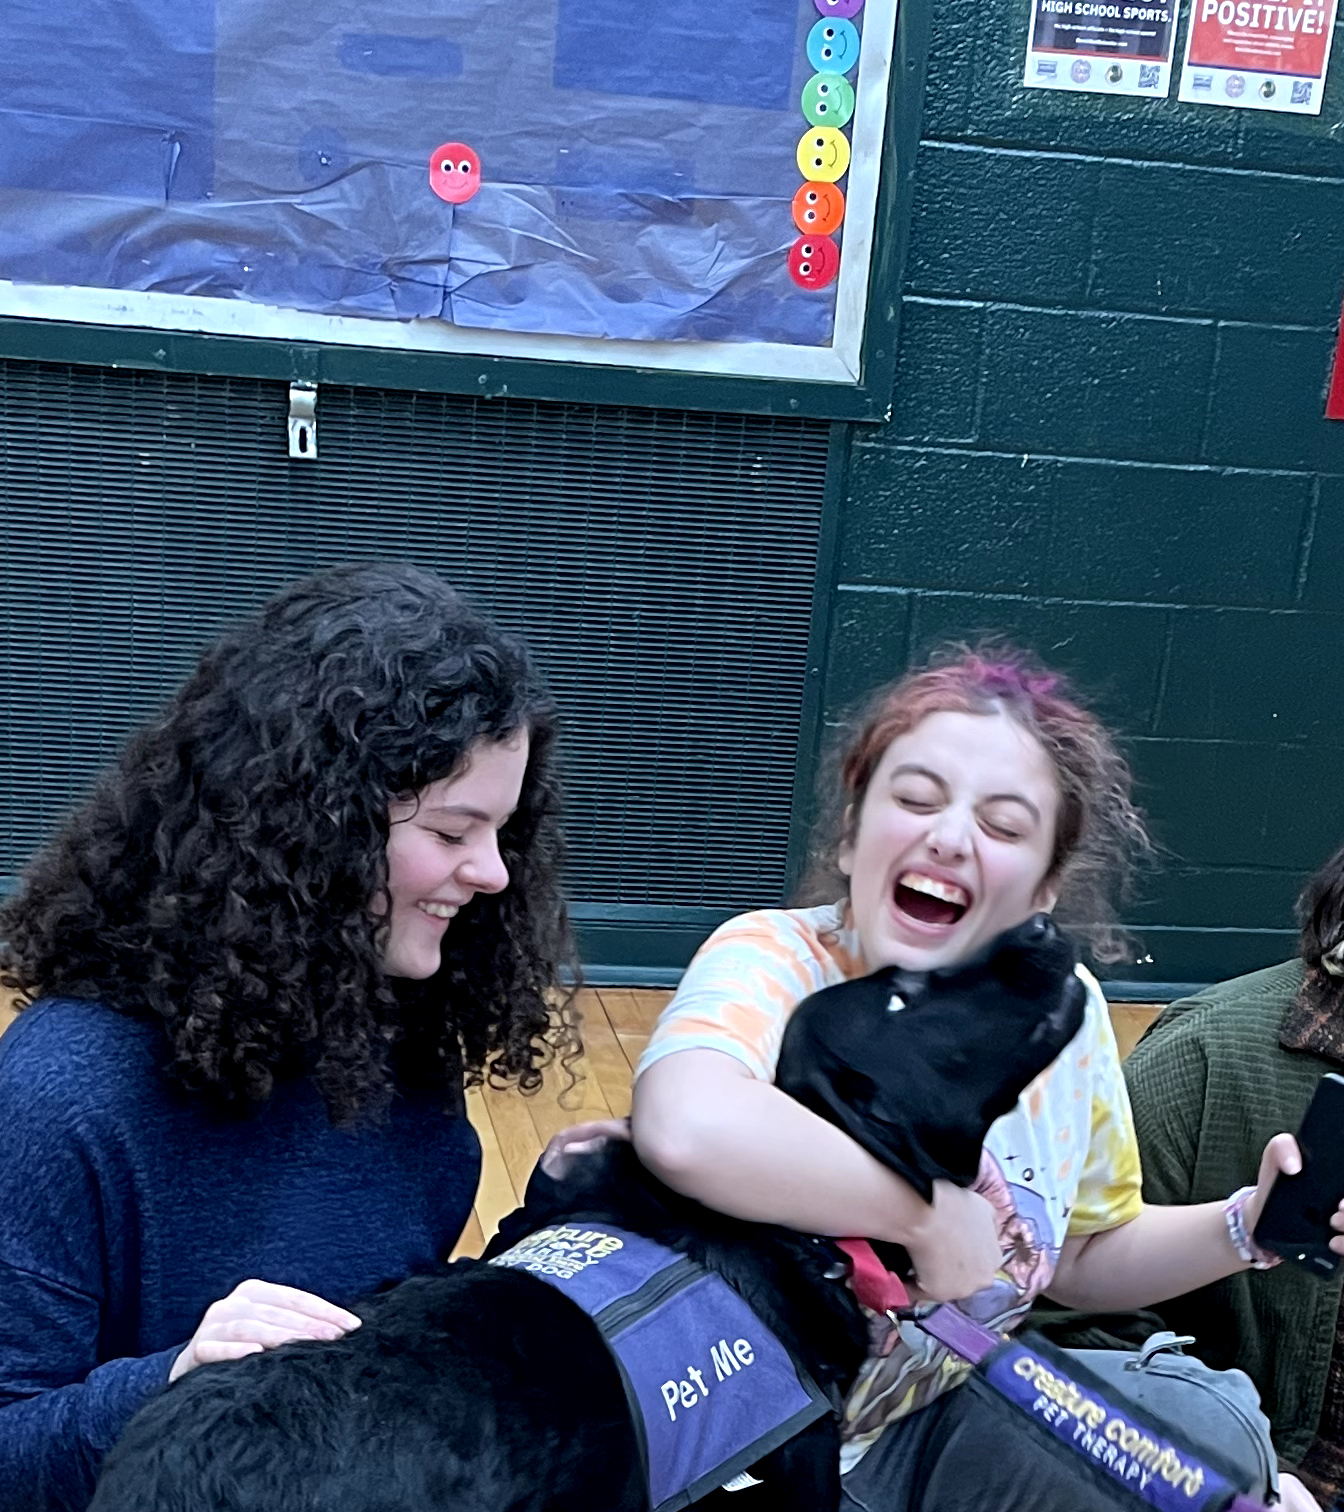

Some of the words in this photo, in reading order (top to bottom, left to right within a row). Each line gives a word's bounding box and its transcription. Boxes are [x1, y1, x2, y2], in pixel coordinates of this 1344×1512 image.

[1041, 0, 1073, 14] HIGH
[1074, 3, 1121, 18] SCHOOL
[1123, 7, 1172, 22] SPORTS.
[1201, 0, 1325, 35] POSITIVE!
[525, 1262, 574, 1280] DOG
[660, 1365, 709, 1422] Pet
[710, 1338, 755, 1382] Me
[1033, 1394, 1069, 1428] PET
[1073, 1421, 1153, 1491] THERAPY
[1105, 1418, 1205, 1498] comfort
